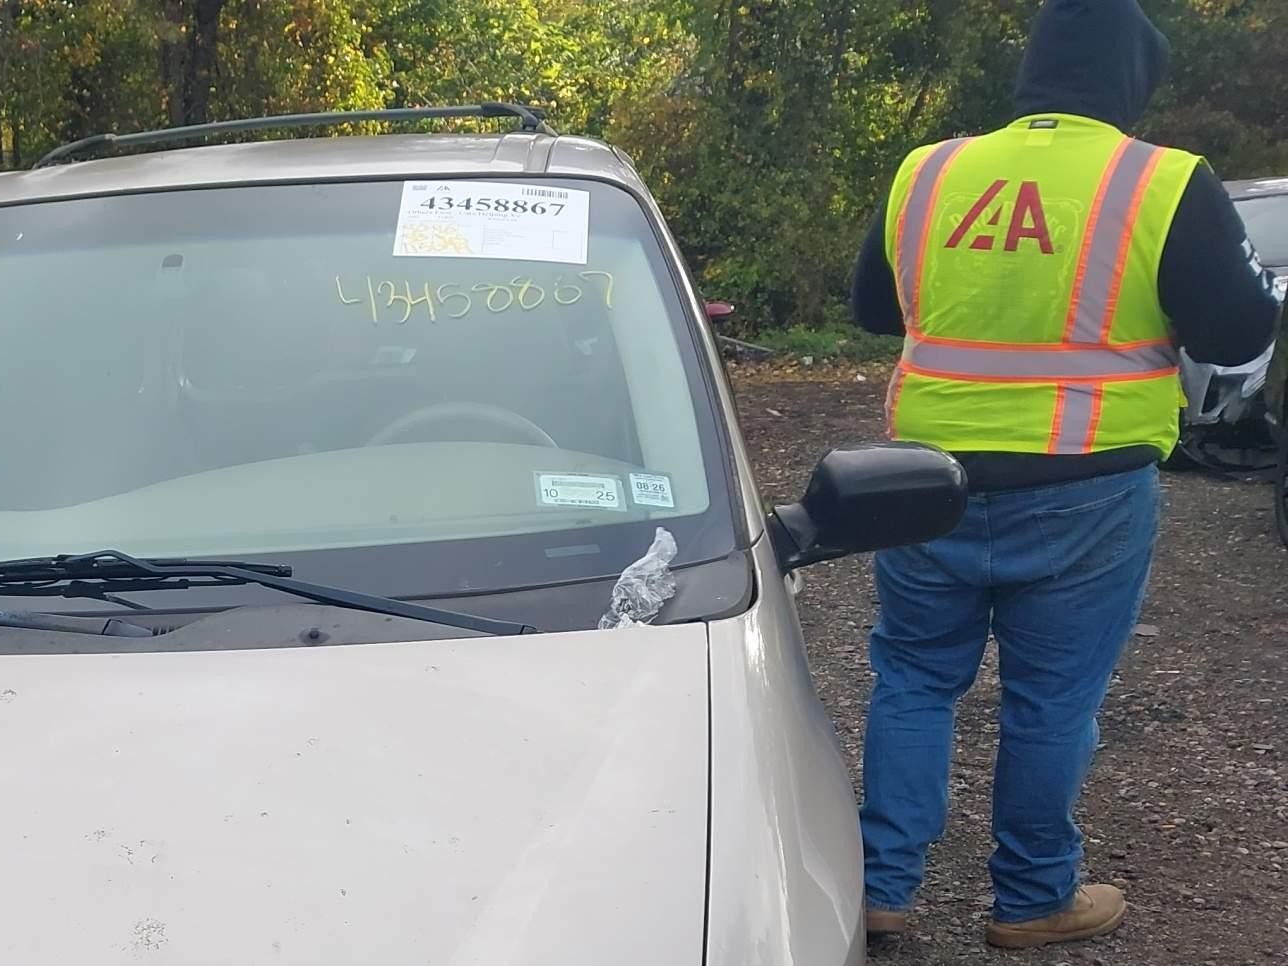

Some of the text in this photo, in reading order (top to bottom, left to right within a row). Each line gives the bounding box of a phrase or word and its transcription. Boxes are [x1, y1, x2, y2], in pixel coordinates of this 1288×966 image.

[419, 195, 566, 217] 43458867
[543, 488, 616, 501] 10 25
